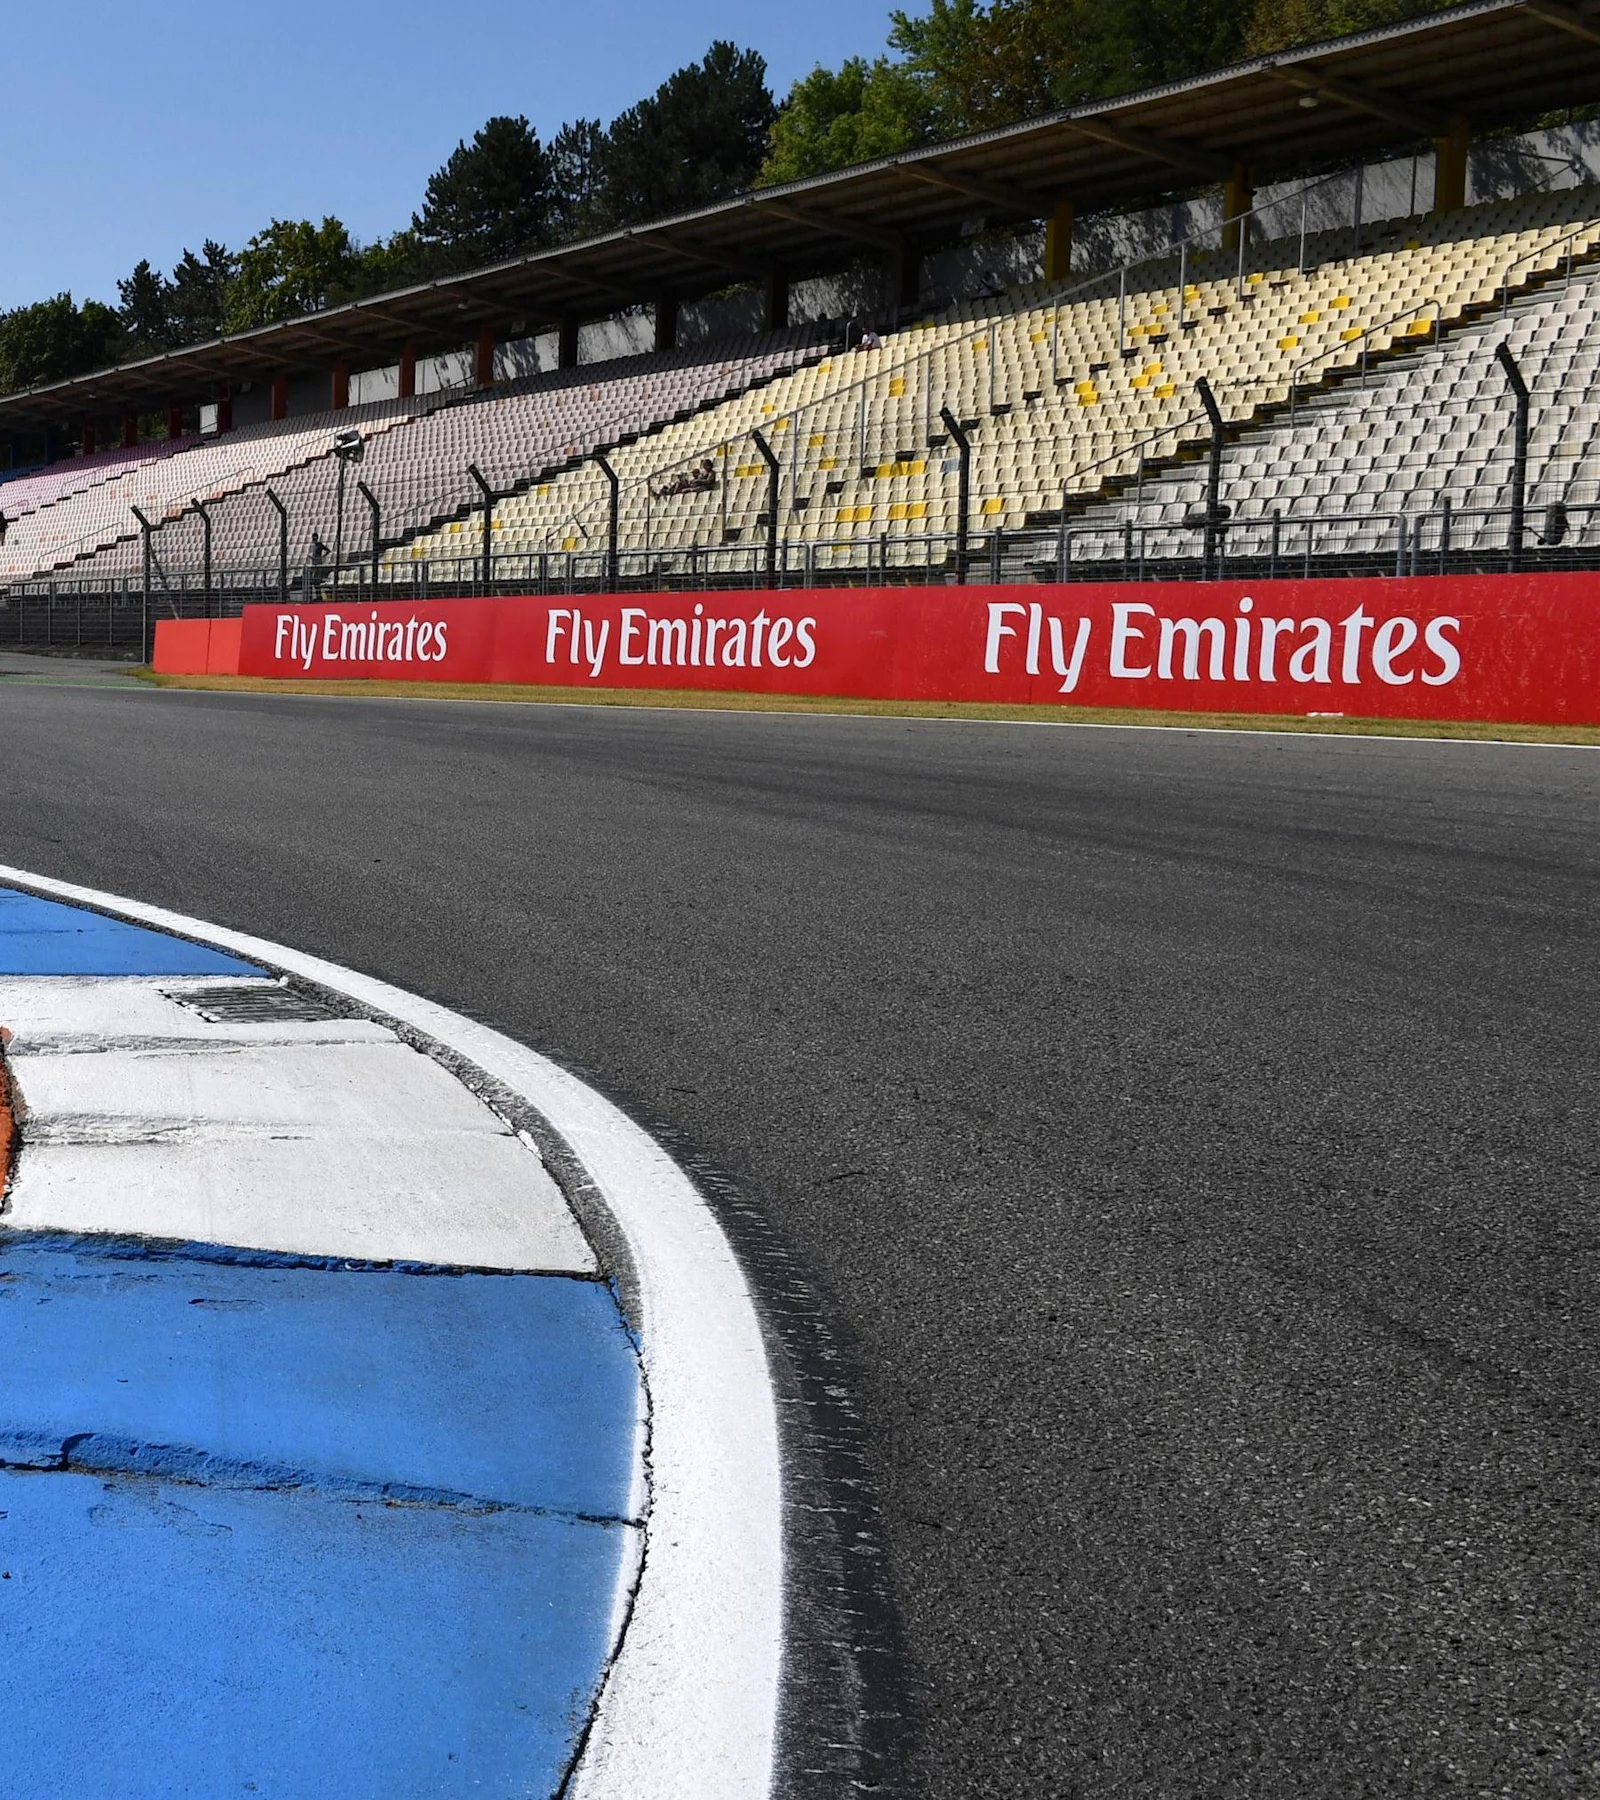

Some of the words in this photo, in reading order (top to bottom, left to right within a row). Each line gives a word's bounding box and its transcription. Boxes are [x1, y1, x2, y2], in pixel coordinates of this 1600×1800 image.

[275, 614, 318, 670] Fly
[322, 610, 448, 661] Emirates
[545, 608, 610, 678] Fly
[619, 603, 817, 668] Emirates
[983, 602, 1092, 693] Fly
[1109, 597, 1461, 686] Emirates
